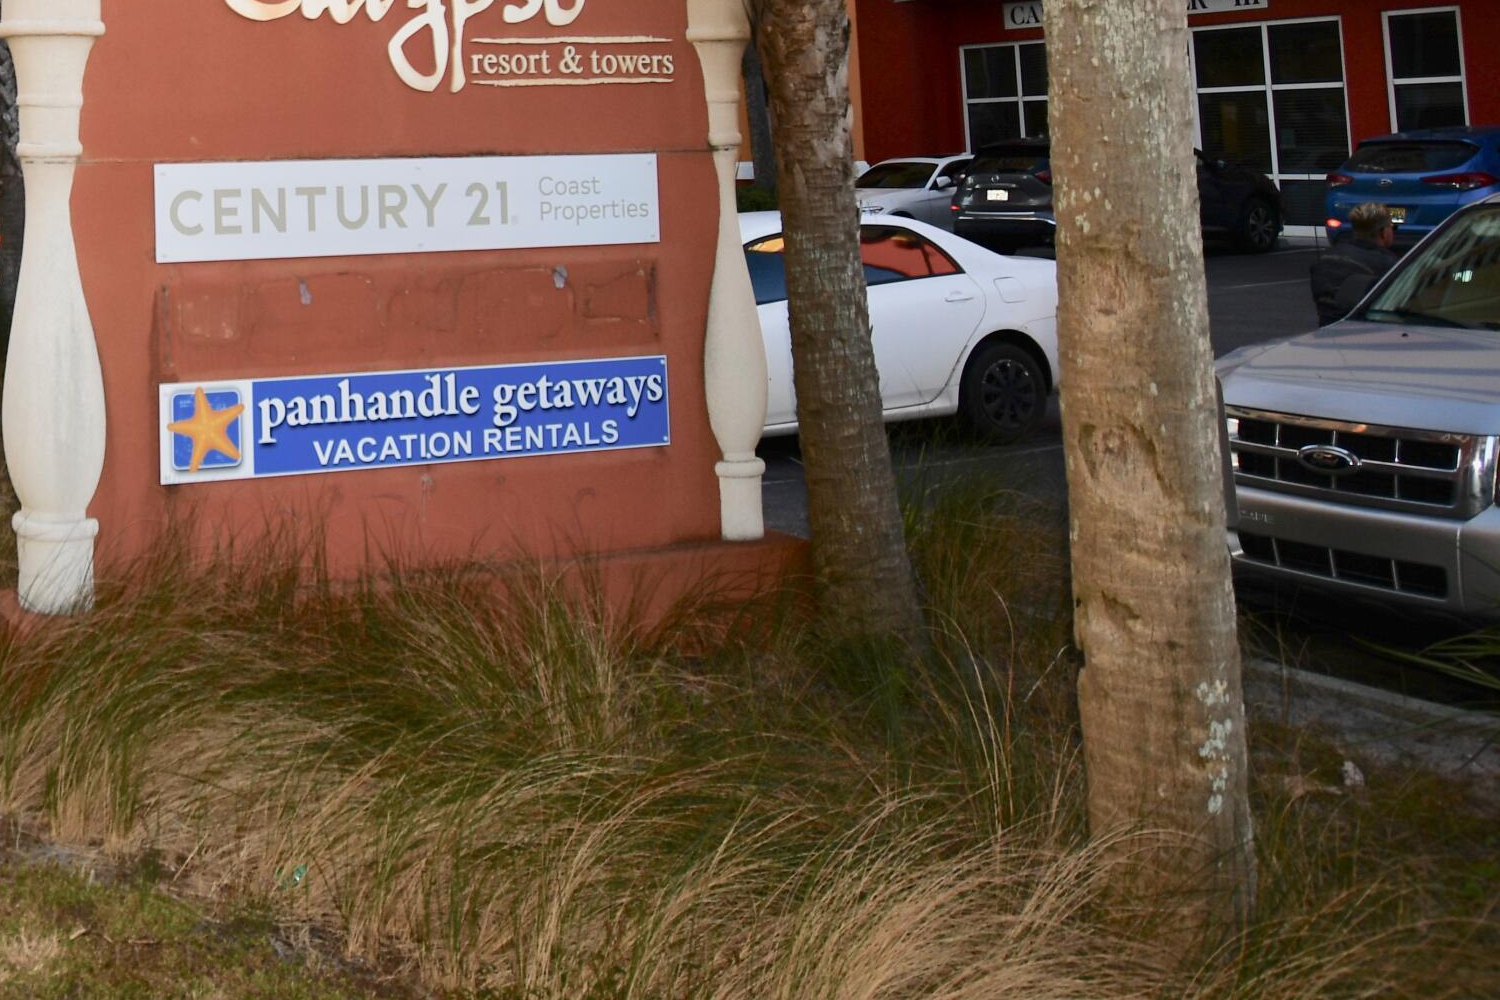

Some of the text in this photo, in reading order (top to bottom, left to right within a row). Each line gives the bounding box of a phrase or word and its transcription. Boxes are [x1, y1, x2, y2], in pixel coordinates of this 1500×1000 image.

[470, 45, 675, 75] resort & towers
[538, 176, 602, 197] Coast
[169, 181, 509, 236] CENTURY 21
[539, 199, 650, 226] Properties
[257, 372, 664, 445] panhandle getaways
[312, 419, 620, 466] VACATION RENTALS
